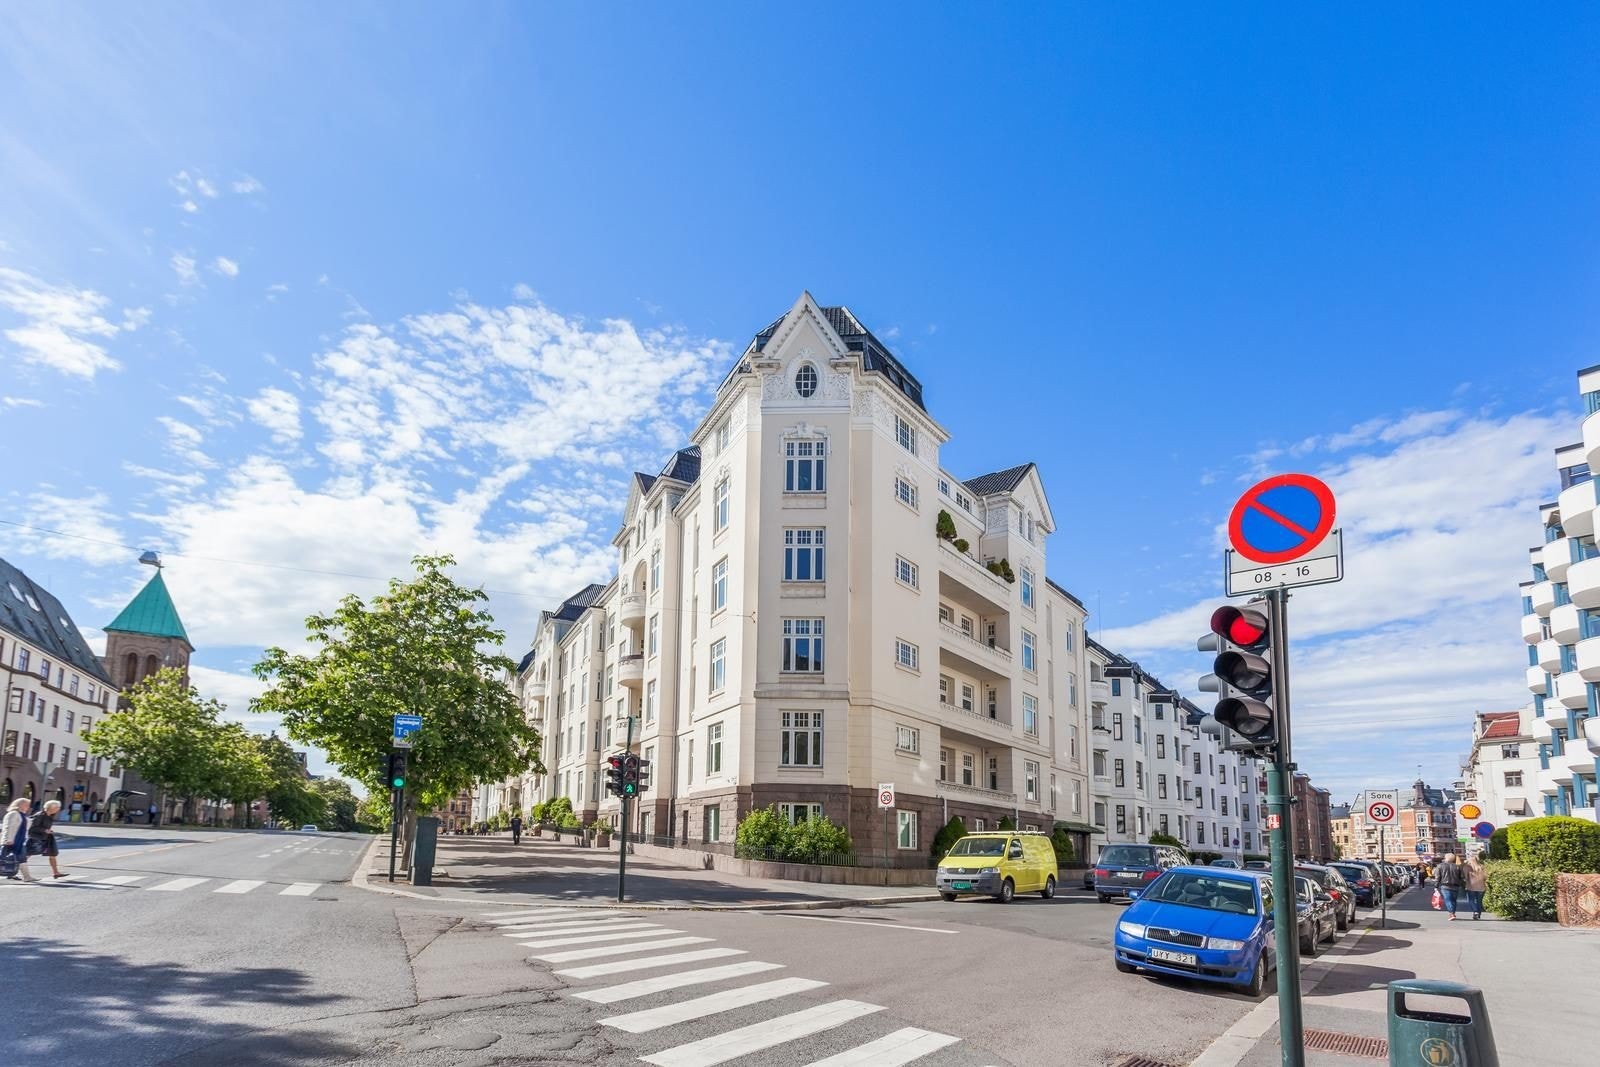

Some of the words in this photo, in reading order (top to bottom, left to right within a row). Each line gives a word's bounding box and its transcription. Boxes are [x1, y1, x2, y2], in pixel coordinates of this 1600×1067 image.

[1254, 571, 1272, 584] 08
[1296, 565, 1310, 577] 16
[1370, 792, 1393, 800] Sone
[1374, 807, 1390, 817] 30
[1153, 949, 1170, 959] UYY
[1176, 953, 1193, 963] 321
